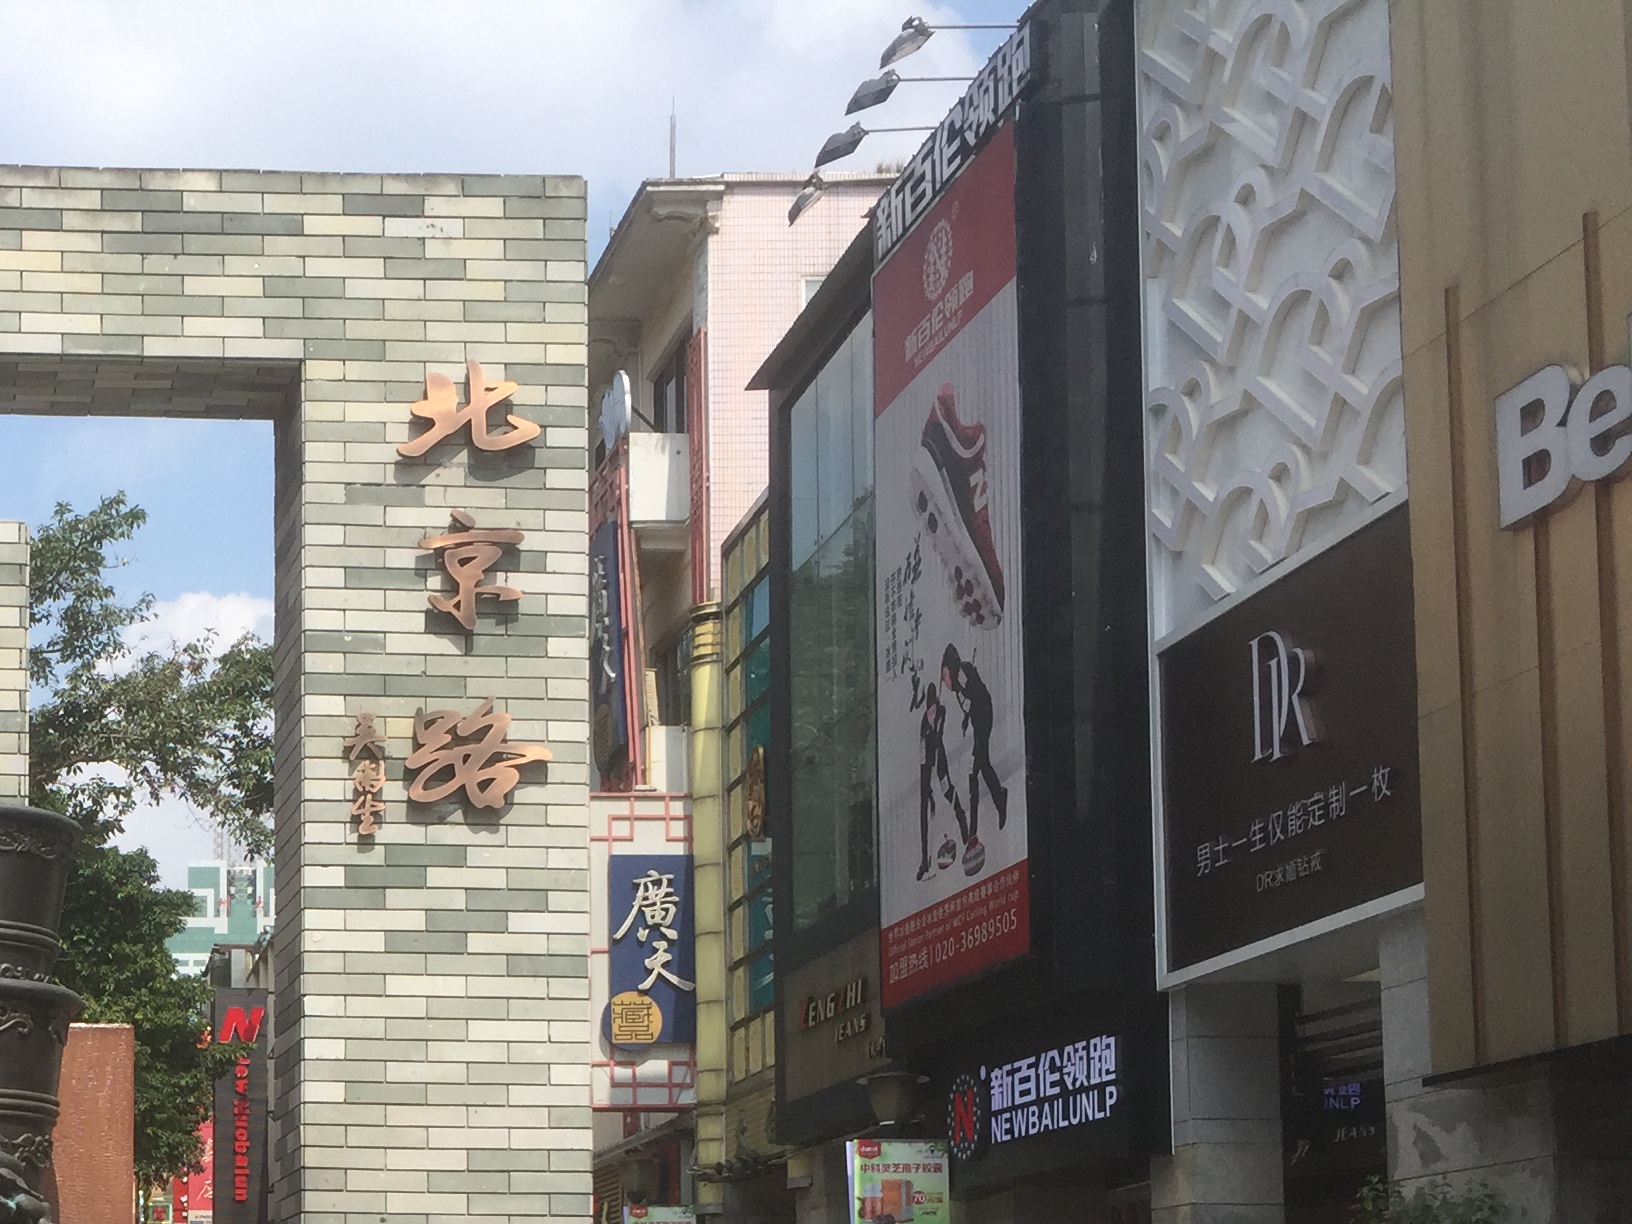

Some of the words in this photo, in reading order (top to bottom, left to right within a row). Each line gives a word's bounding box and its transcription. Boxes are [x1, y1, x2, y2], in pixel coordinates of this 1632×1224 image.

[876, 20, 1031, 261] 新百伦领跑
[1494, 313, 1632, 529] Be
[395, 358, 553, 808] 北京路
[1248, 630, 1313, 763] DR
[1197, 765, 1392, 877] 男士一生仅能定制一枚
[935, 908, 1018, 963] 020-36989505
[990, 1035, 1117, 1112] 新百伦领跑
[991, 1086, 1118, 1144] NEWBAILUNLP
